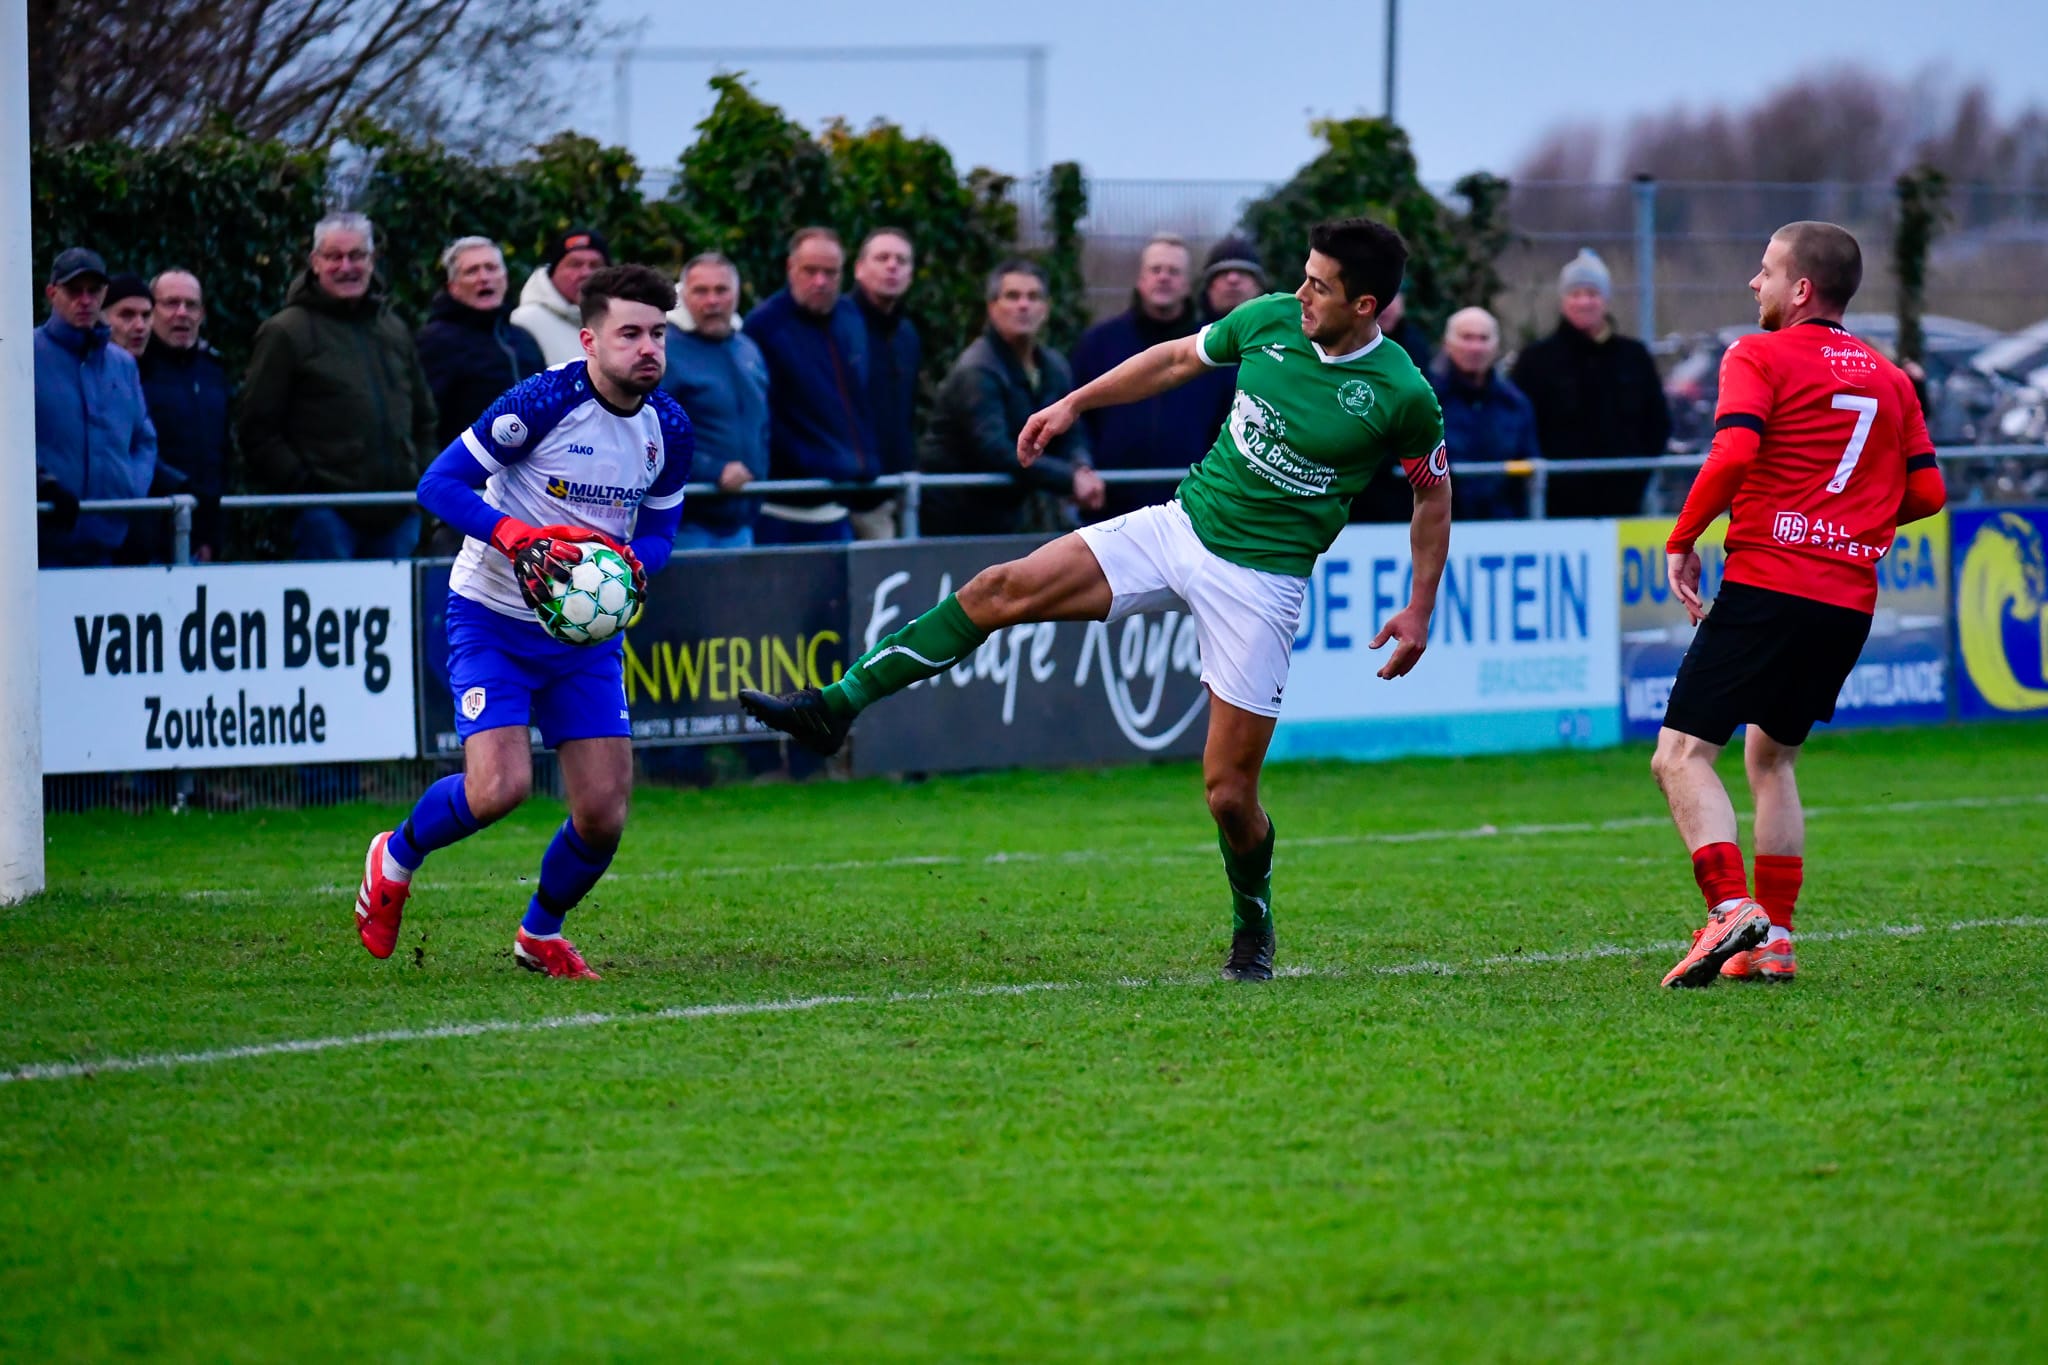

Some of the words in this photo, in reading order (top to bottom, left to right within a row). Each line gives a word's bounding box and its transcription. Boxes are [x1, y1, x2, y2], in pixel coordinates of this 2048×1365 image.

[567, 444, 594, 456] JAKO
[1826, 394, 1878, 494] 7
[569, 495, 613, 506] TOWAGE
[1812, 518, 1851, 538] ALL
[1811, 534, 1888, 558] SAFETY
[75, 611, 165, 676] van
[179, 584, 267, 672] den
[283, 588, 392, 694] Berg
[145, 687, 326, 750] Zoutelande
